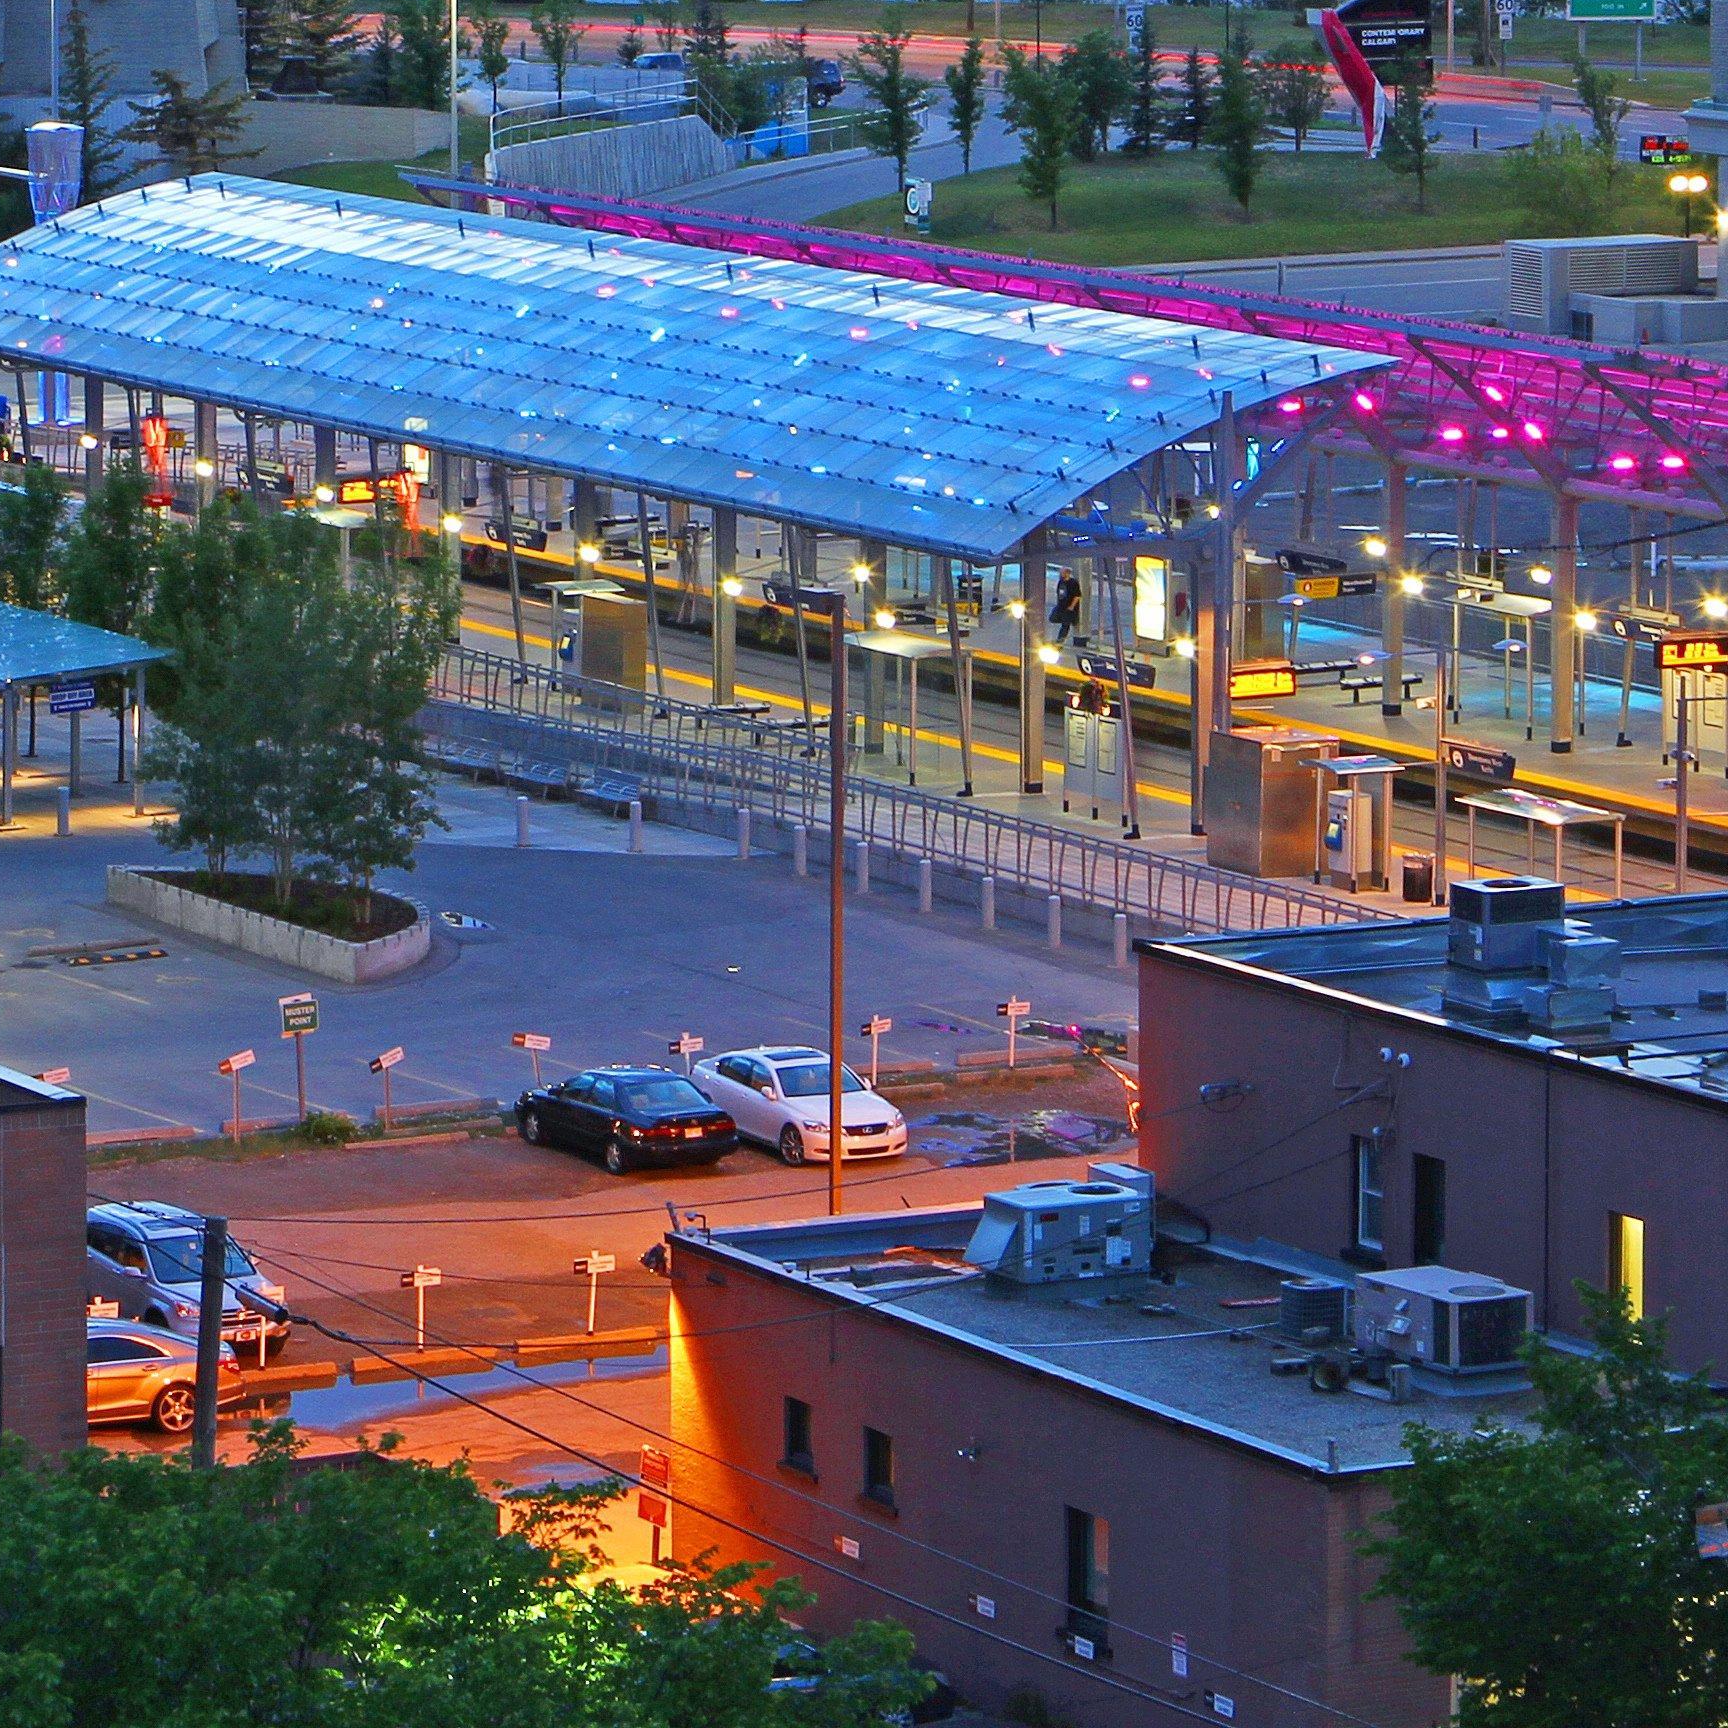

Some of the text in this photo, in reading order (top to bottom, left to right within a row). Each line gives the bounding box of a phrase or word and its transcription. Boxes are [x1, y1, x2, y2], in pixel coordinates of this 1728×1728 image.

[1127, 14, 1143, 27] 60
[1361, 28, 1425, 38] CONTEMORARY
[289, 1016, 312, 1026] POINT
